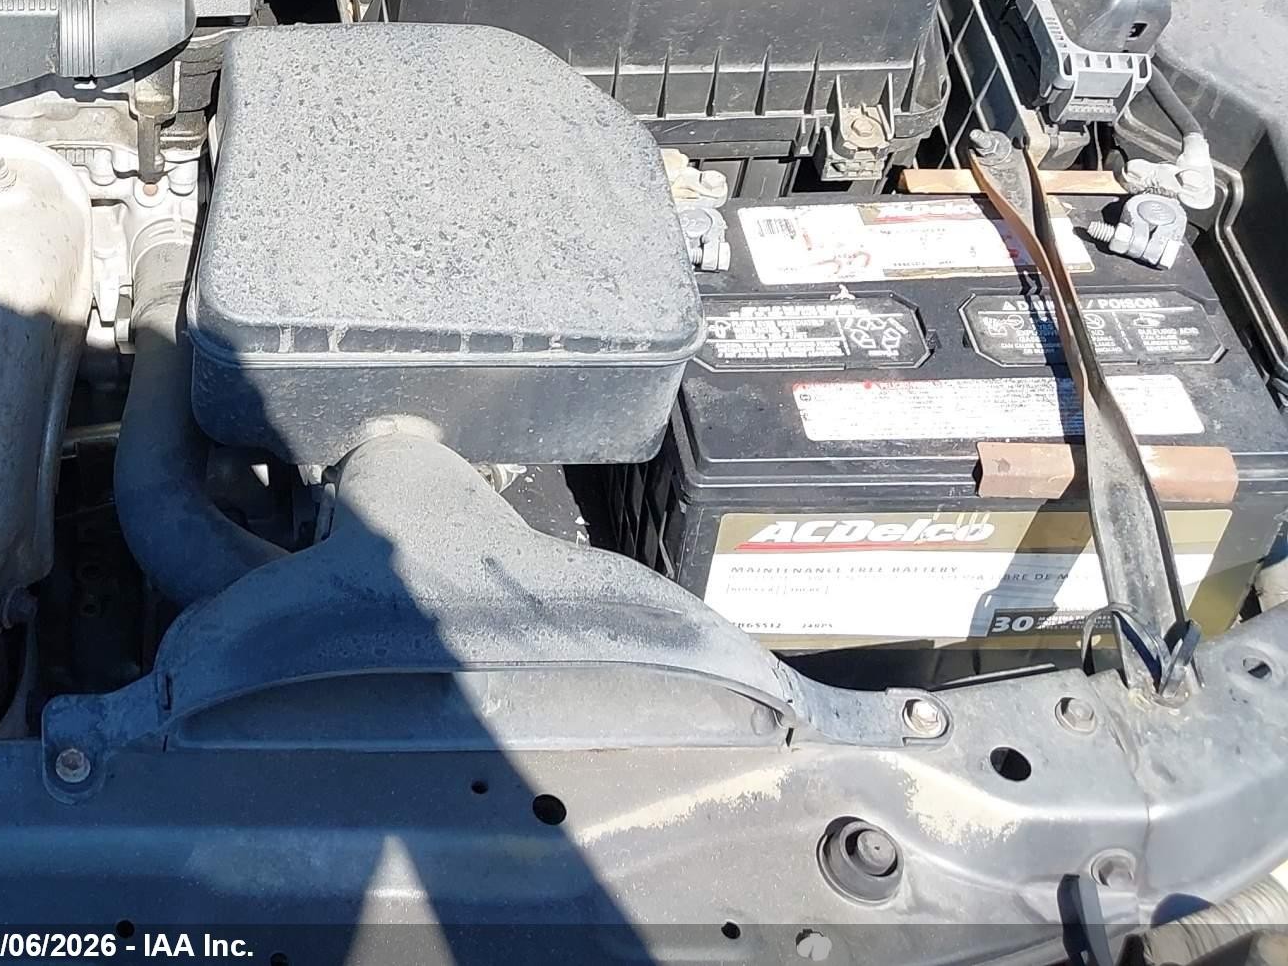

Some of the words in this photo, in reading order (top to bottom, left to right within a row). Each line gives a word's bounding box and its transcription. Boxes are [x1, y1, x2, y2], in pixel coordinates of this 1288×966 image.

[1097, 298, 1161, 309] POISON
[747, 518, 995, 543] ACDelco
[731, 566, 842, 575] MAINTENANCE
[992, 616, 1034, 633] 30
